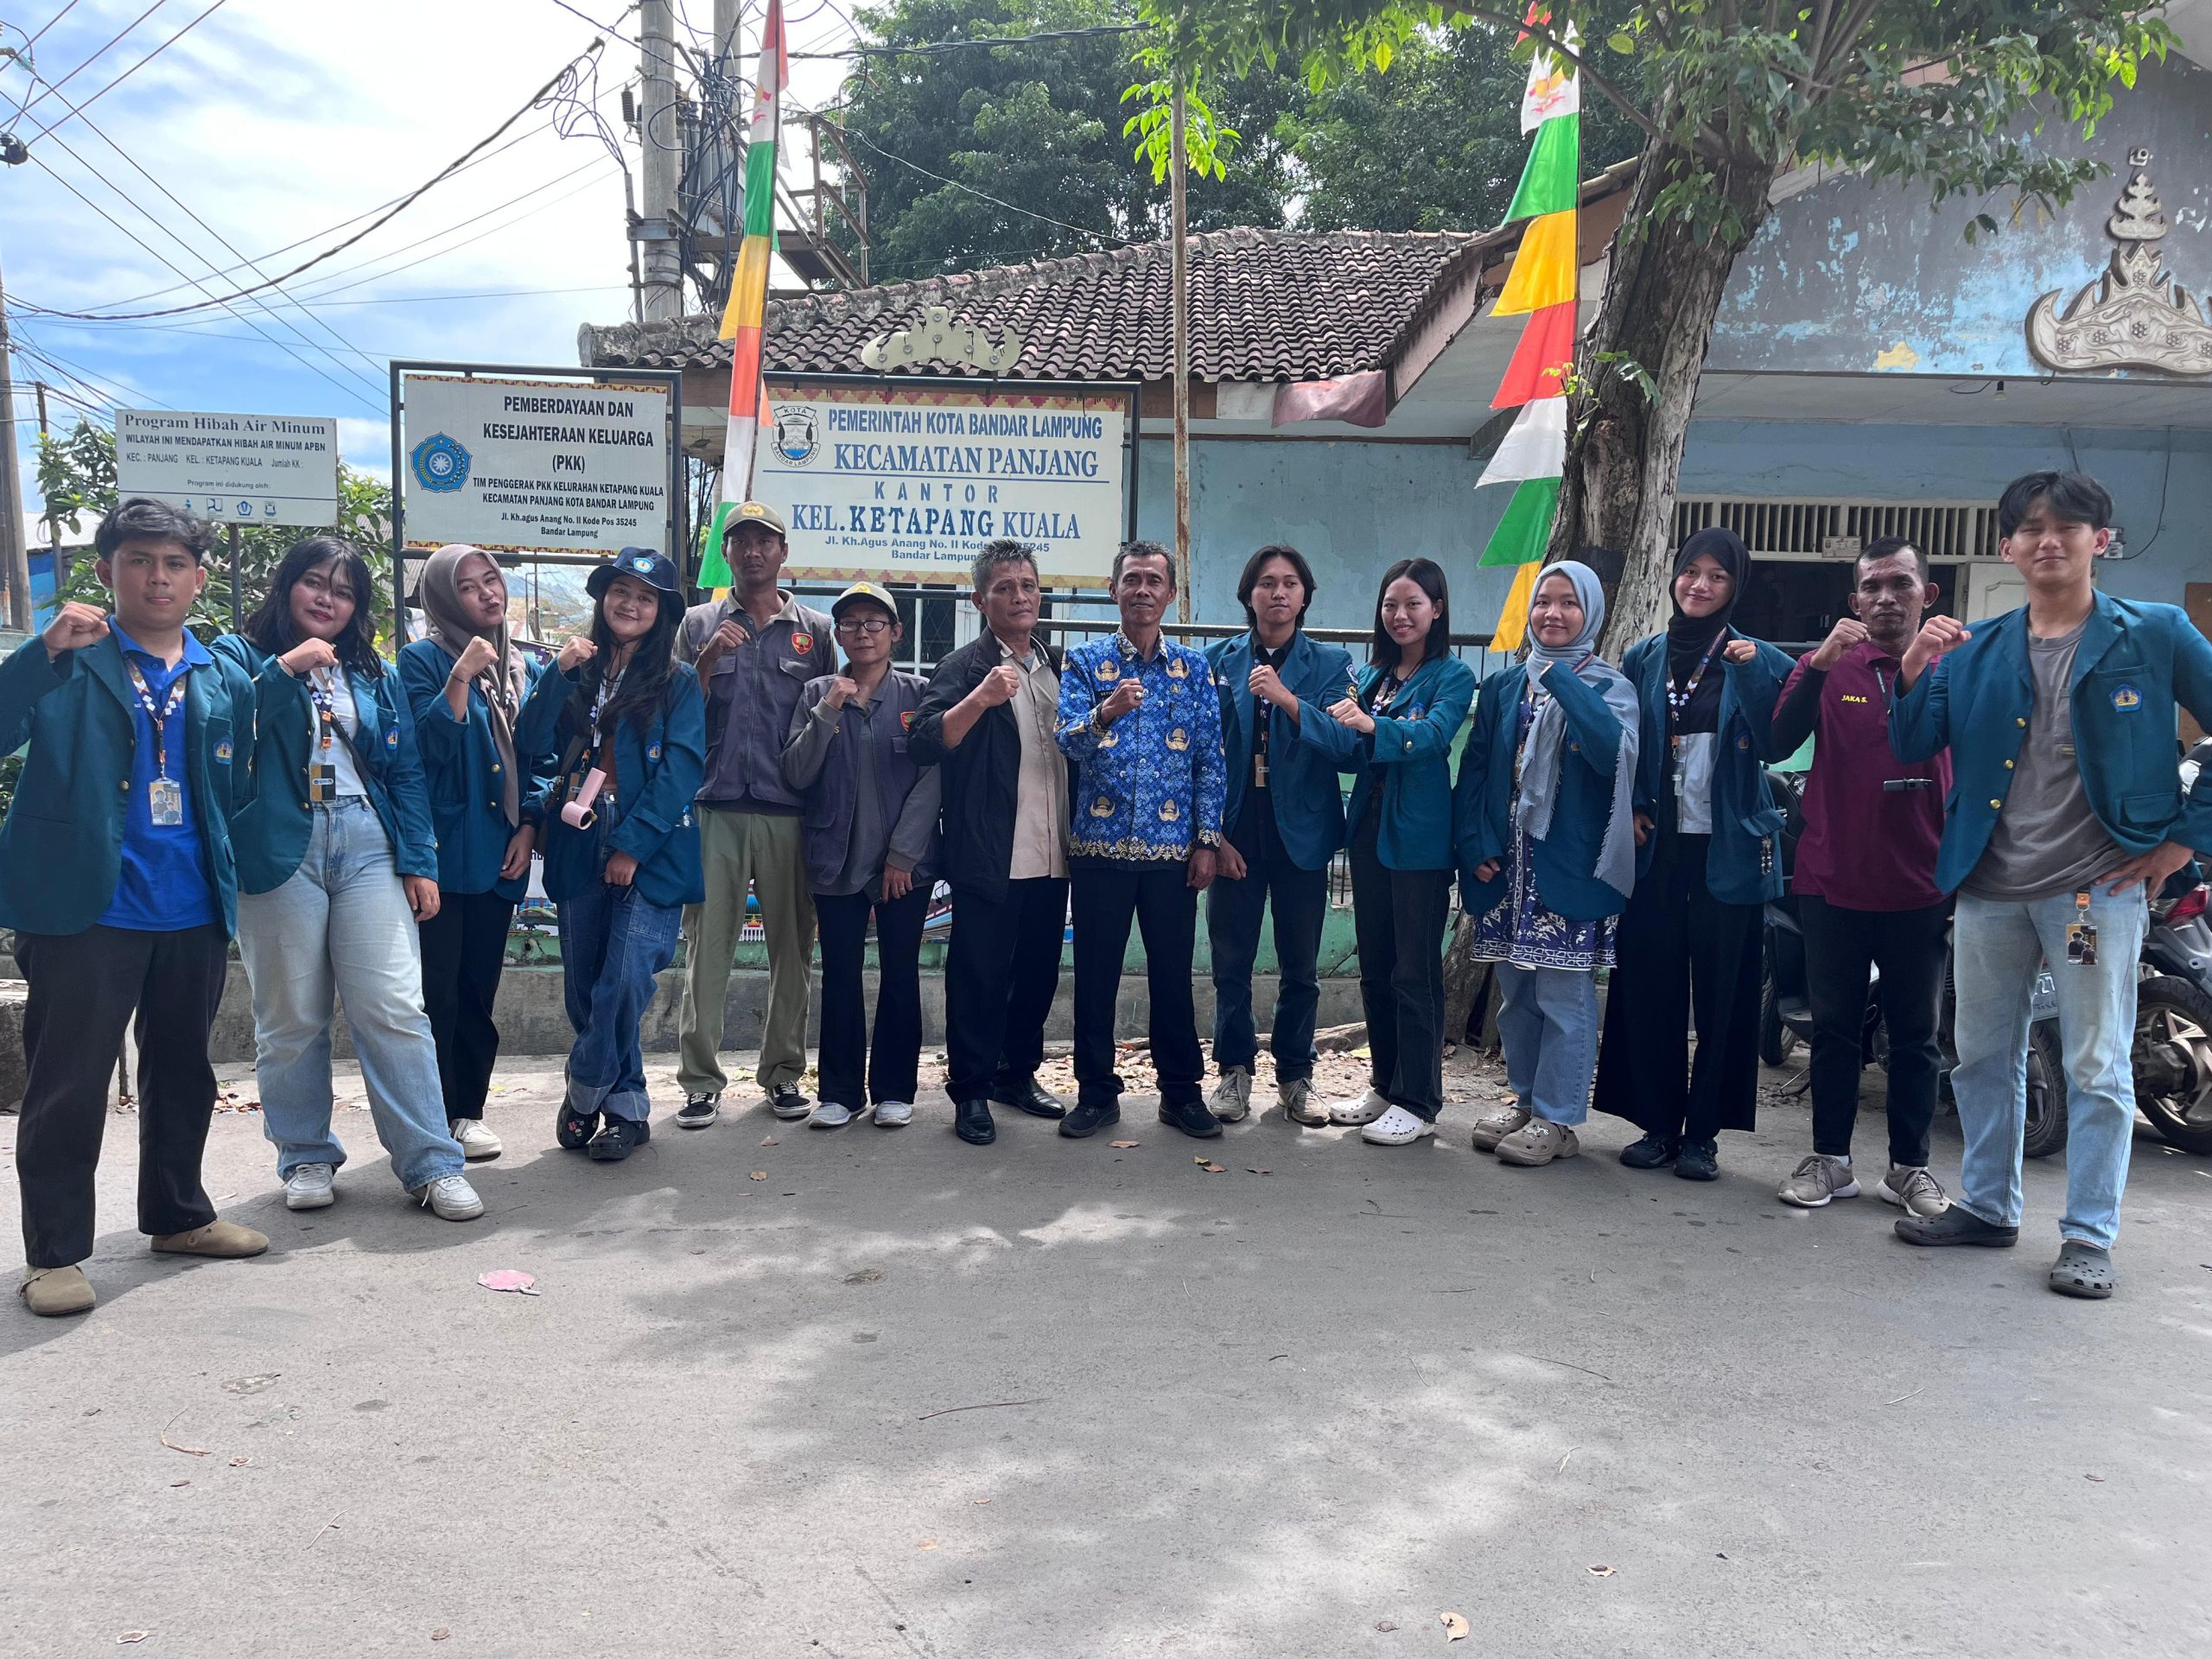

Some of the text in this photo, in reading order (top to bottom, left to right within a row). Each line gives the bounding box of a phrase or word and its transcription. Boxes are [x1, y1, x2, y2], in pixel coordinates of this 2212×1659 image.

[504, 396, 633, 417] PEMBERDAYAAN DAN
[125, 414, 325, 435] Program Hibah Air Minum
[829, 409, 1103, 440] PEMERINTAH KOTA BANDAR LAMPUNG
[125, 434, 326, 452] WILAYAH INI MENDAPATKAN HIBAH AIR MINUM APBN
[483, 423, 654, 447] KESEJAHTERAAN KELUARGA
[147, 453, 179, 464] PANJANG
[206, 454, 239, 466] KETAPANG
[241, 456, 263, 467] KUALA
[270, 458, 291, 467] Jumlah
[291, 459, 300, 468] KK
[552, 454, 586, 474] (PKK)
[773, 446, 817, 466] BANDAR LAMPUNG
[834, 443, 1098, 477] KECAMATAN PANJANG
[187, 479, 214, 487] Program
[225, 480, 254, 490] didukung
[473, 477, 664, 497] TIM PENGGERAK PKK KELURAHAN KETAPANG KUALA
[482, 493, 655, 511] KECAMATAN PANJANG KOTA BANDAR LAMPUNG
[539, 514, 563, 525] Anang
[563, 515, 575, 524] No.
[582, 517, 601, 525] Kode
[601, 517, 614, 526] Pos
[615, 518, 637, 527] 35245
[1002, 512, 1081, 539] KUALA
[540, 526, 599, 539] Bandar Lampung
[842, 536, 888, 549] Kh.Agus
[891, 538, 926, 550] Anang
[929, 539, 948, 549] No.
[891, 550, 931, 560] Bandar
[1841, 694, 1860, 702] JAKA
